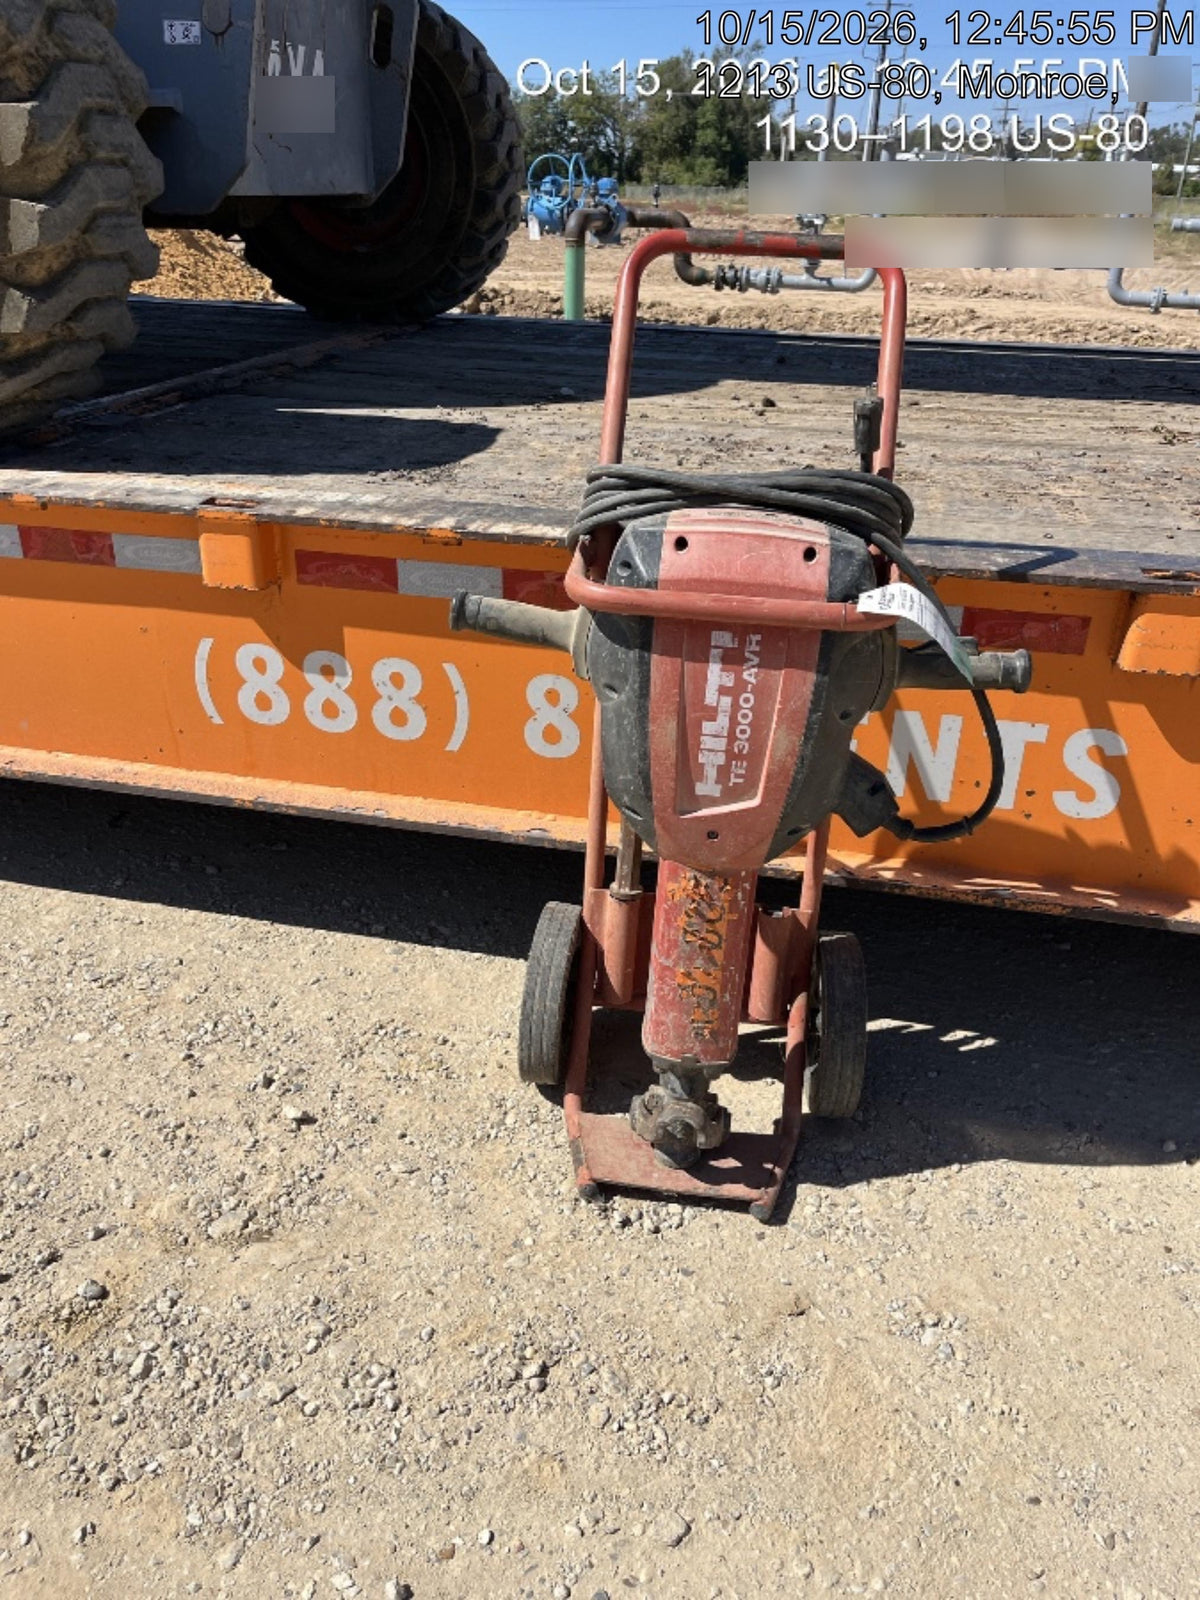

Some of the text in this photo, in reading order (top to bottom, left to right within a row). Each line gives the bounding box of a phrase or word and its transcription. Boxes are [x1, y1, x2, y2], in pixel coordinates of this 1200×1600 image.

[194, 637, 470, 752] (888)
[695, 630, 739, 797] HILTI
[728, 633, 762, 787] TE 3000-AVR
